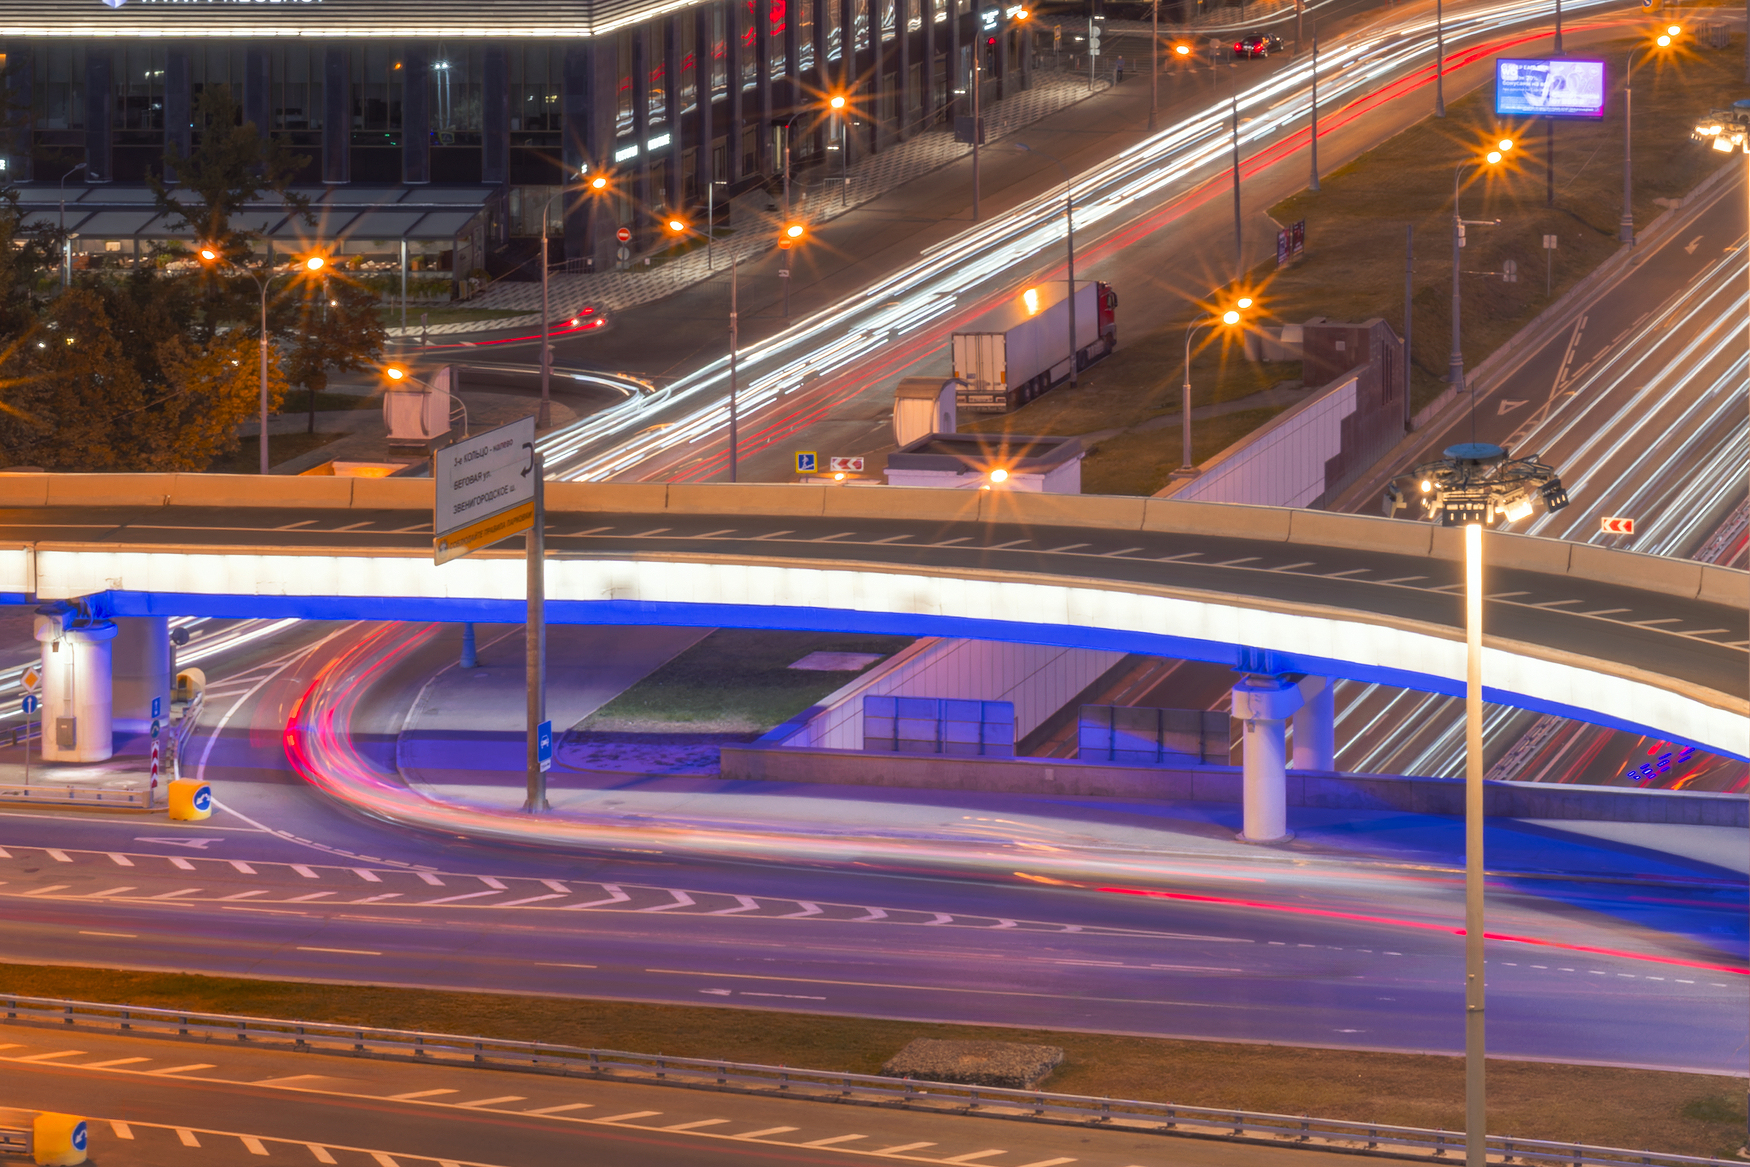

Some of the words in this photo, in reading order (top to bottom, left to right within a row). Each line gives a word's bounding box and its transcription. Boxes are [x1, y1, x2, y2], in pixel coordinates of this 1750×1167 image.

[454, 457, 463, 467] 3-е
[463, 446, 488, 464] КОЛЬЦО
[493, 439, 514, 452] налево
[453, 471, 482, 491] БЕГОВАЯ
[453, 484, 509, 514] ЗВЕНИГОРОДСКОЕ
